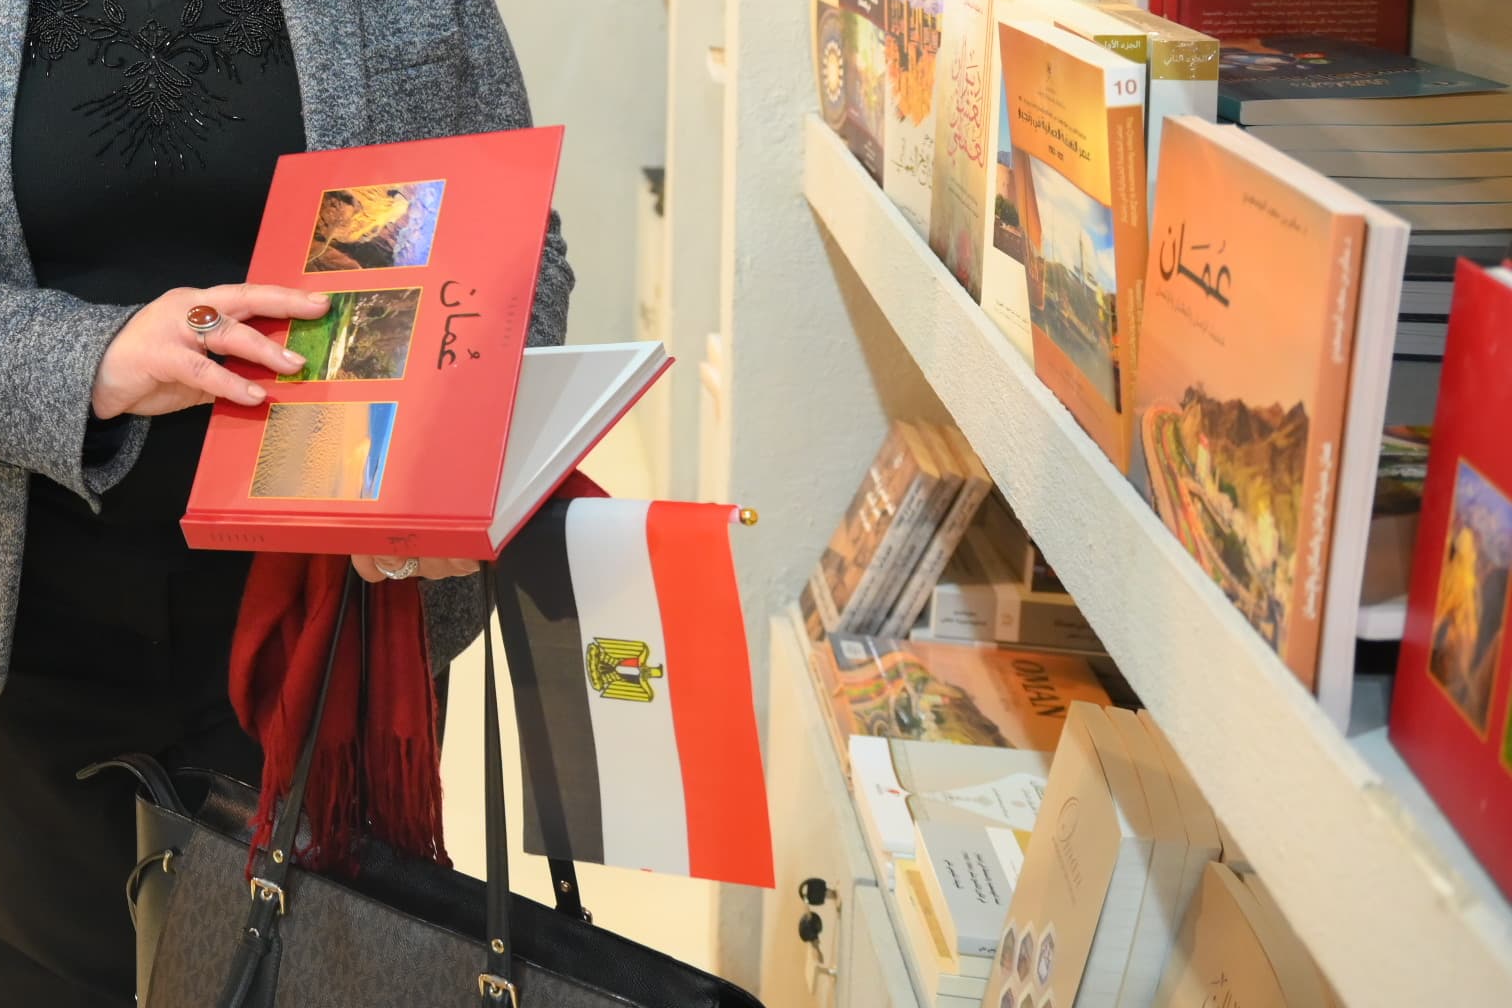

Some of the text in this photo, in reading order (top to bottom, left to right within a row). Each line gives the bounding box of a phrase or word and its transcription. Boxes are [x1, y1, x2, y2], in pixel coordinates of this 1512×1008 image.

[1121, 40, 1142, 50] الجزء
[1114, 79, 1137, 95] 10
[1011, 659, 1068, 719] OMAN
